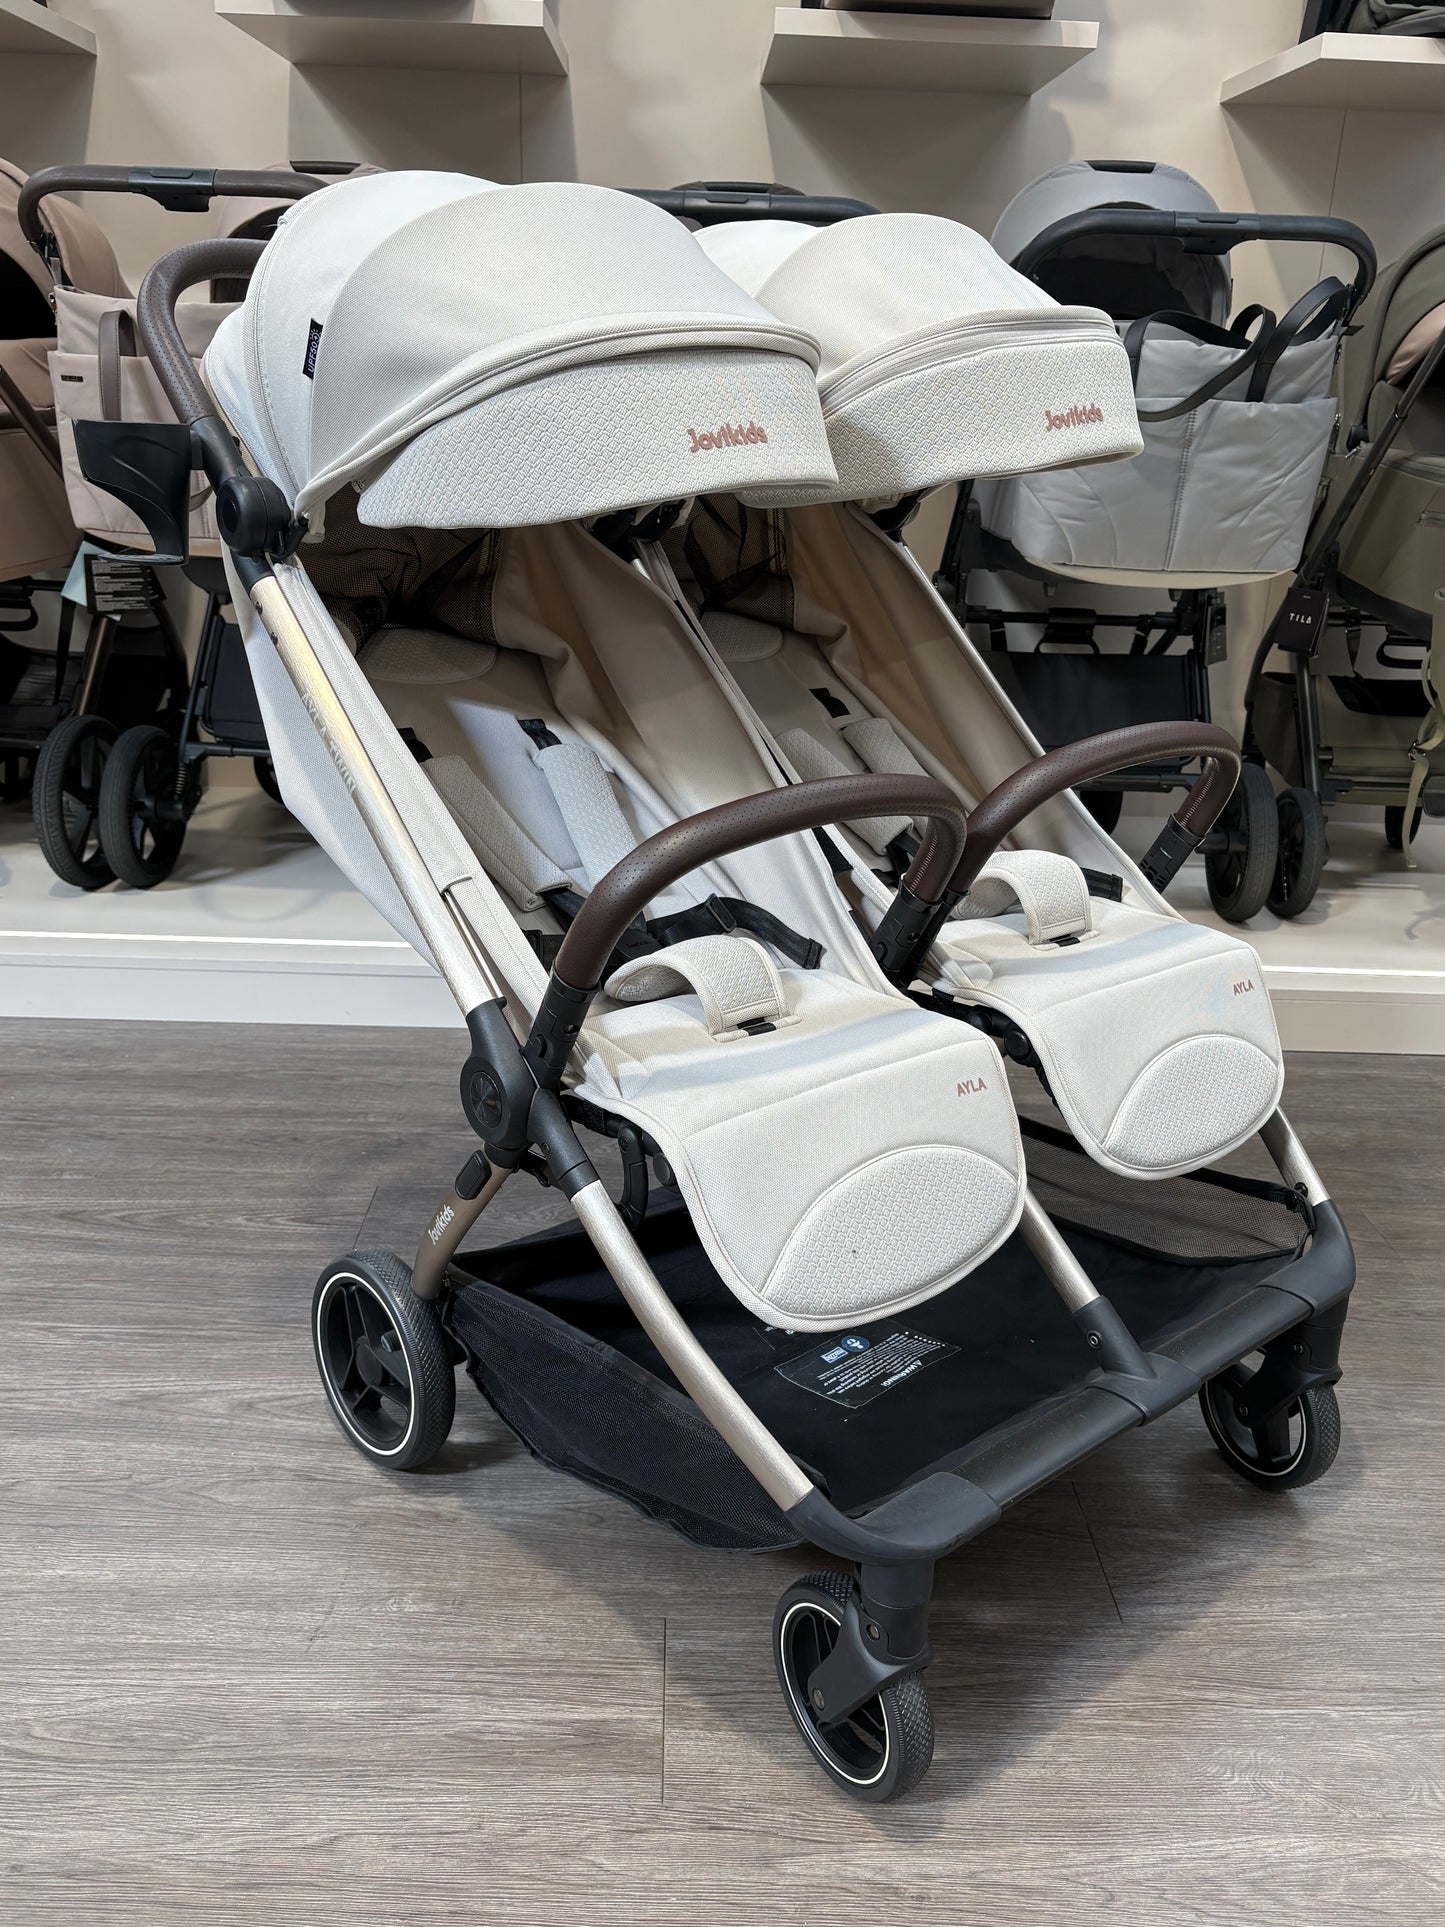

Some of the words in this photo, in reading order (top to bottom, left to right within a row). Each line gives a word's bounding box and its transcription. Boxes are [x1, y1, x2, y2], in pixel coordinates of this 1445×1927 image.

[1045, 402, 1103, 432] Jovikids
[687, 420, 768, 453] Jovikids
[1289, 612, 1312, 624] TILA
[1233, 979, 1254, 996] AYLA
[957, 1077, 987, 1097] AYLA
